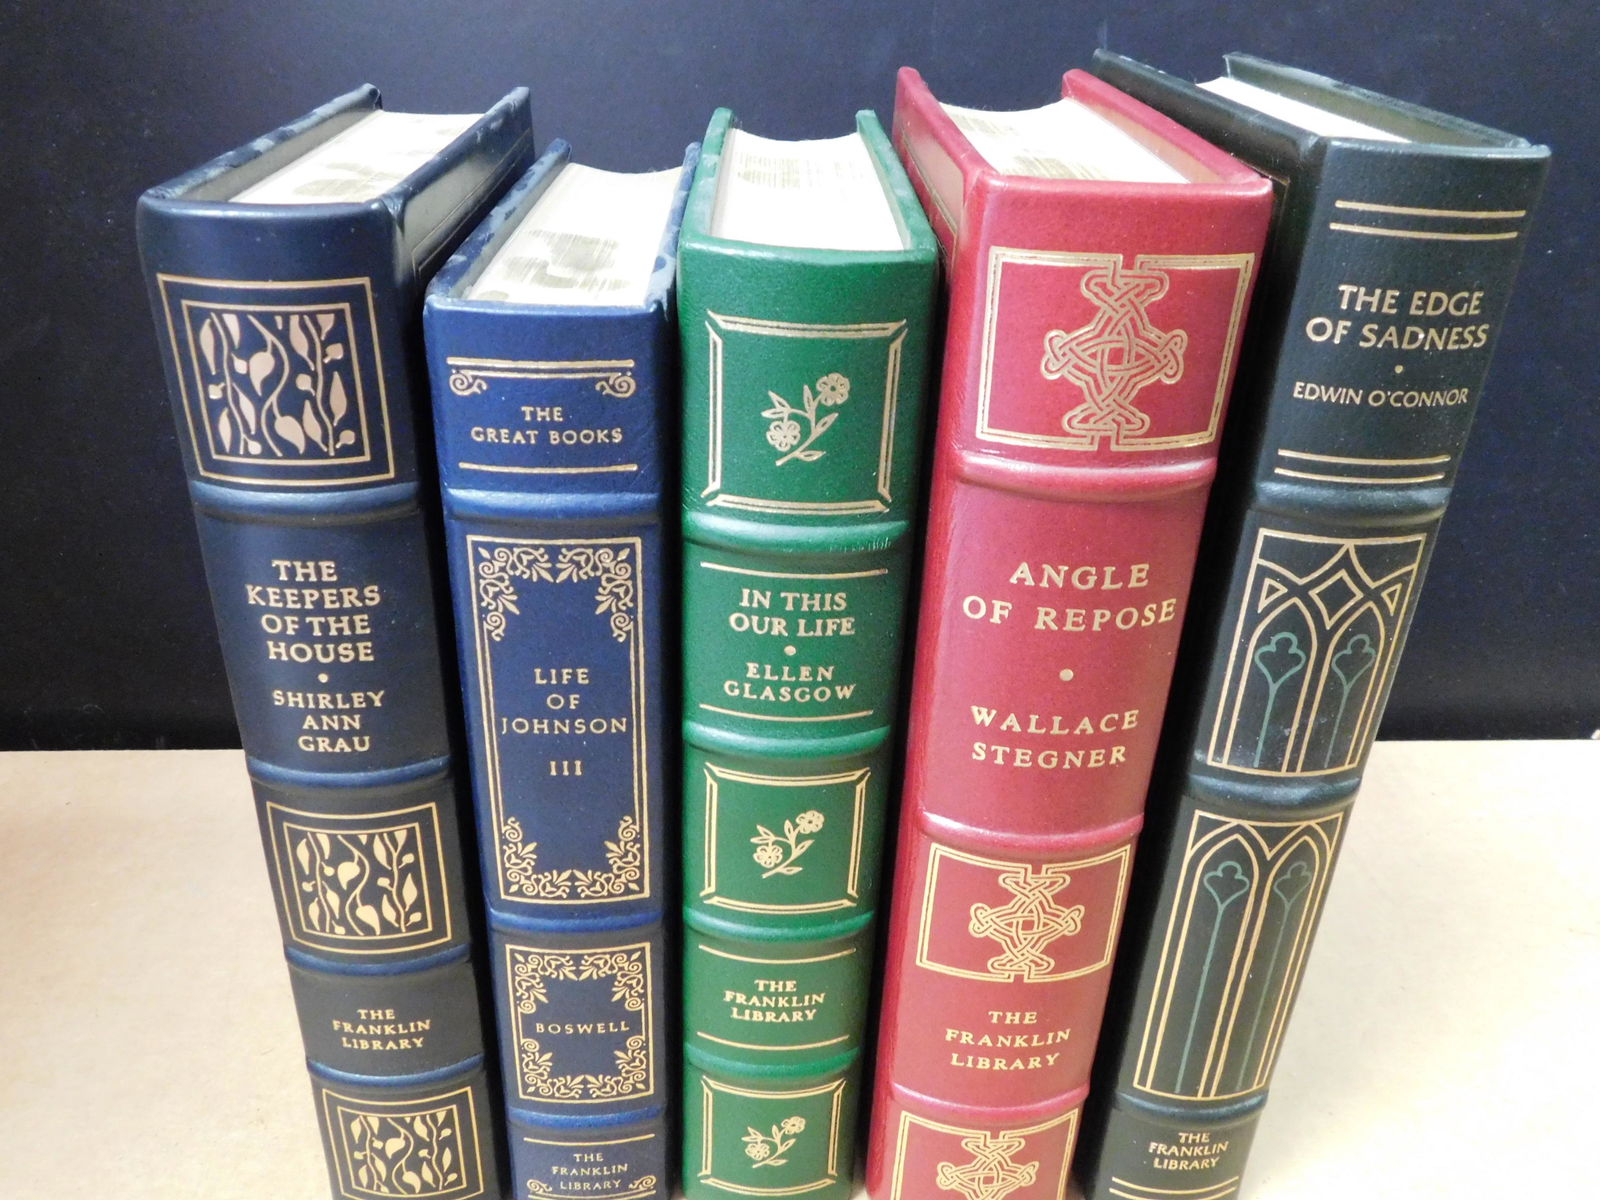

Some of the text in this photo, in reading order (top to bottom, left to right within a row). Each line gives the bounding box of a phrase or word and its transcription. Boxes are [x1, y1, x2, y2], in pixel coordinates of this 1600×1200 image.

[1337, 284, 1484, 316] THE EDGE
[1305, 316, 1489, 350] OF SADNESS
[1292, 381, 1468, 407] EDWIN O'CONNOR
[520, 405, 563, 421] THE
[470, 426, 622, 445] GREAT BOOKS
[271, 559, 337, 581] THE
[1008, 561, 1149, 589] ANGLE
[245, 584, 380, 609] KEEPERS
[739, 588, 846, 611] IN THIS
[962, 595, 1176, 631] OF REPOSE
[260, 613, 370, 636] OF THE
[728, 612, 855, 637] OUR LIFE
[266, 640, 373, 663] HOUSE
[533, 667, 589, 684] LIFE
[745, 661, 834, 681] ELLEN
[271, 689, 384, 709] SHIRLEY
[723, 679, 855, 702] GLASGOW
[546, 693, 579, 709] OF
[302, 714, 360, 730] ANN
[501, 717, 626, 734] JOHNSON
[970, 704, 1138, 734] WALLACE
[297, 735, 369, 752] GRAU
[971, 741, 1125, 768] STEGNER
[549, 759, 581, 776] III
[754, 979, 796, 992] THE
[723, 989, 825, 1007] FRANKLIN
[356, 1008, 395, 1020] THE
[730, 1006, 816, 1022] LIBRARY
[987, 1010, 1037, 1024] THE
[332, 1019, 430, 1035] FRANKLIN
[535, 1020, 629, 1034] BOSWELL
[341, 1036, 423, 1050] LIBRARY
[944, 1028, 1070, 1047] FRANKLIN
[950, 1052, 1059, 1070] LIBRARY
[1178, 1132, 1209, 1143] THE
[1148, 1140, 1228, 1156] FRANKLIN
[572, 1152, 603, 1162] THE
[1153, 1156, 1219, 1170] LIBRARY
[551, 1163, 627, 1176] FRANKLIN
[559, 1179, 620, 1190] LIBRARY
